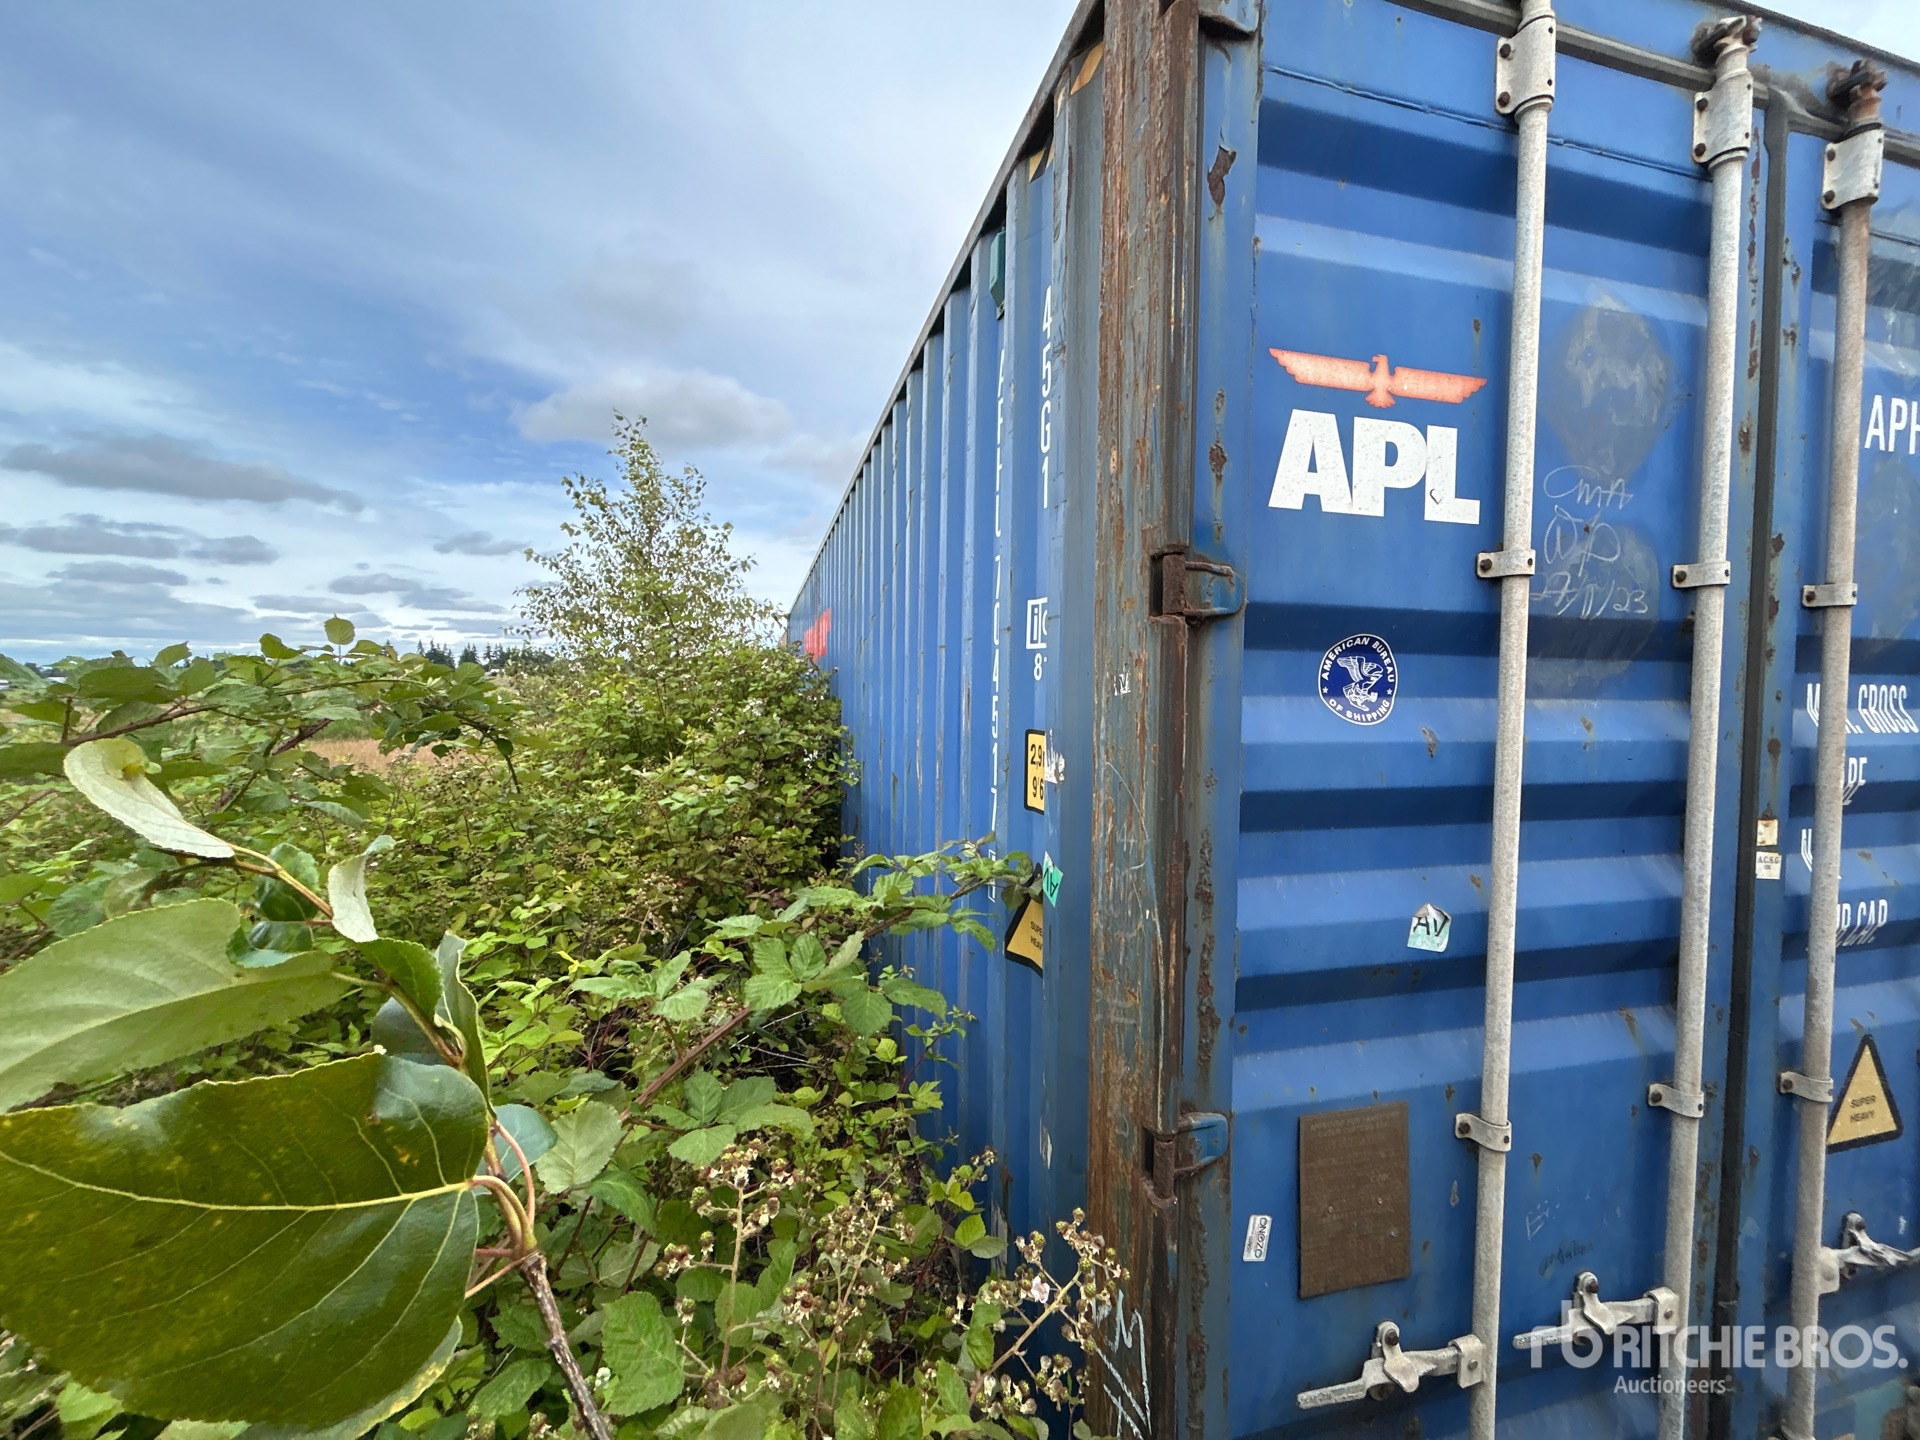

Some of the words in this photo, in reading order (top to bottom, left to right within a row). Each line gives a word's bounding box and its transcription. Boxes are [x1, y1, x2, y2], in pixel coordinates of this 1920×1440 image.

[1041, 285, 1053, 509] 45G1
[1268, 409, 1480, 525] APL
[1322, 637, 1370, 681] AMERICAN
[1372, 641, 1395, 683] BUREAU
[1329, 699, 1344, 712] OF
[1345, 700, 1390, 722] SHIPPING
[1858, 684, 1919, 734] GROSS
[1850, 1095, 1876, 1108] SUPER
